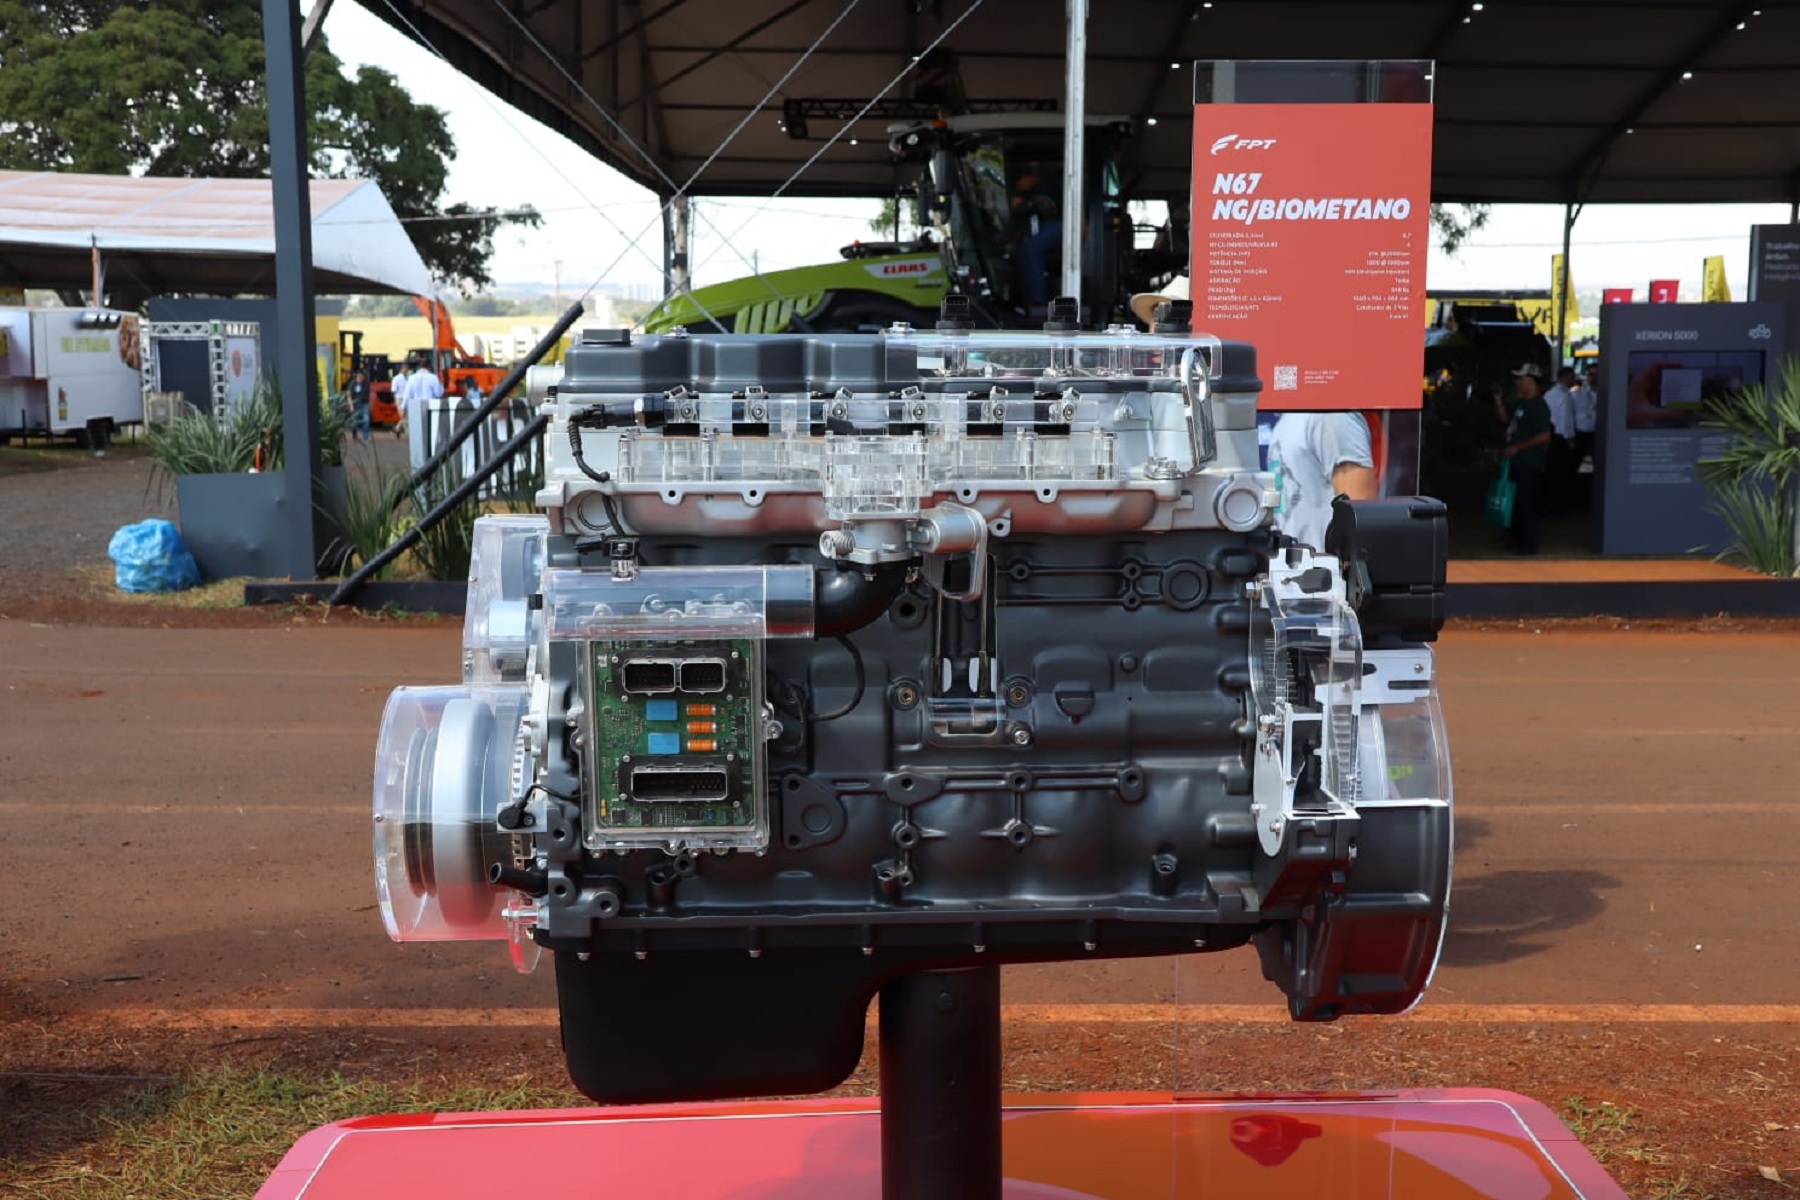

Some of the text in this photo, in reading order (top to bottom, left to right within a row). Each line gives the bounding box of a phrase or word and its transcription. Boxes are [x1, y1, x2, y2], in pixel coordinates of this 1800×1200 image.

[1234, 139, 1277, 150] FPT
[1212, 173, 1263, 195] N67
[1211, 198, 1411, 225] NG/BIOMETANO
[883, 263, 928, 274] CLAAS
[1635, 330, 1672, 341] XERION
